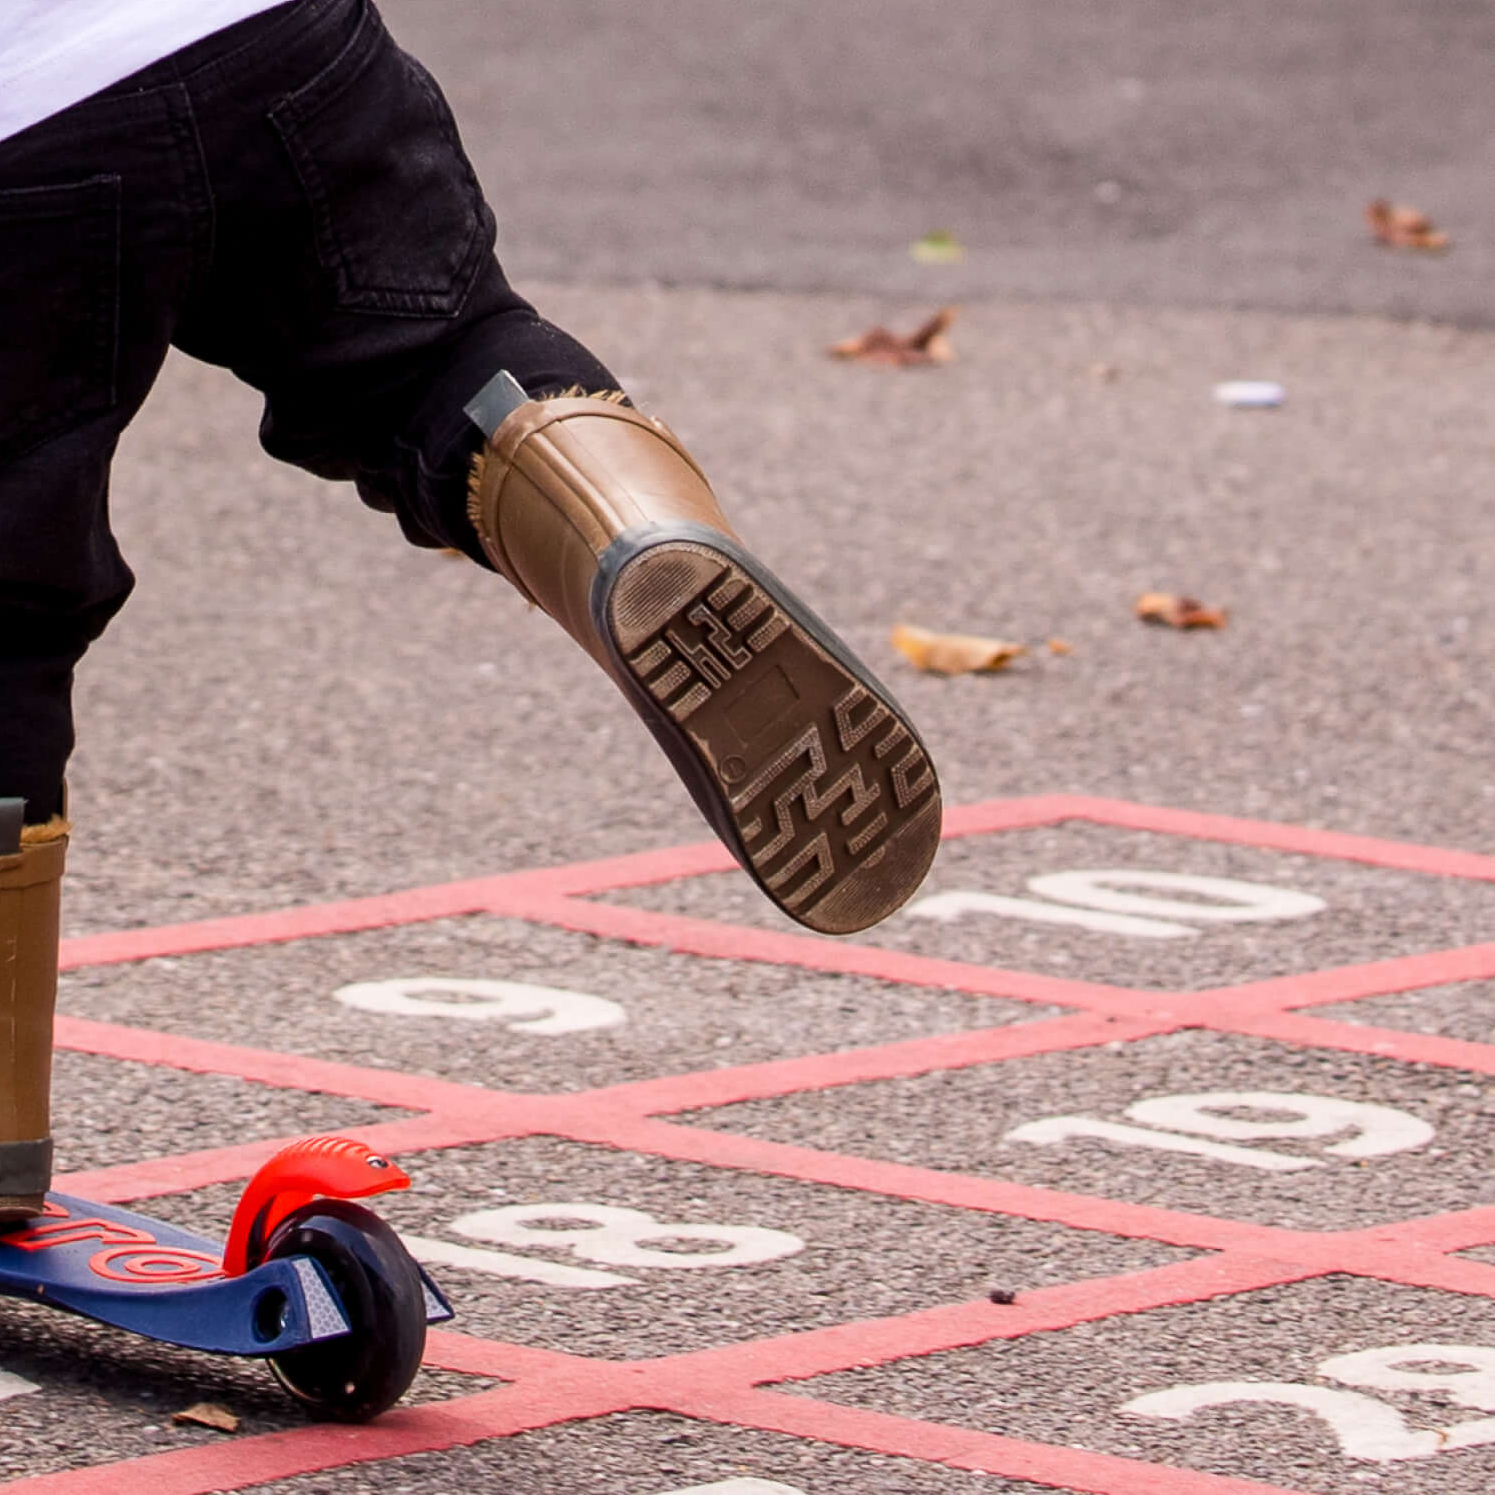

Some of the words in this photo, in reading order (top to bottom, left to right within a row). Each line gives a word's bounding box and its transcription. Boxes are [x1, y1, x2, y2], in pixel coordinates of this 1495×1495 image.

[908, 867, 1327, 940] 10
[332, 976, 628, 1036] 9
[1006, 1090, 1437, 1172] 19
[398, 1202, 806, 1288] 18
